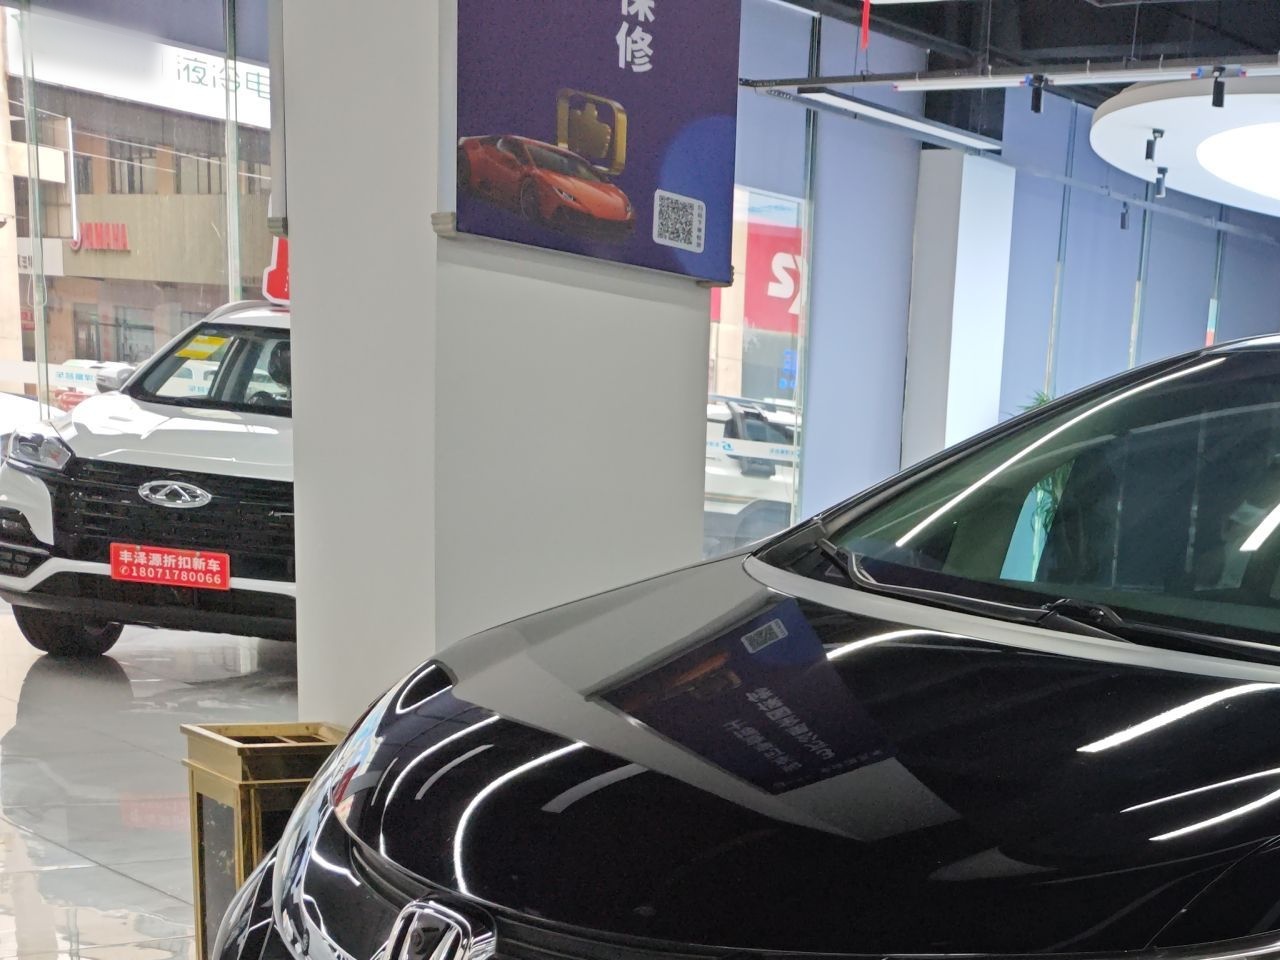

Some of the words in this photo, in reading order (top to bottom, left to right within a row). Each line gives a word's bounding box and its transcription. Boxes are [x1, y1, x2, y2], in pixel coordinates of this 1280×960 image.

[119, 550, 221, 572] 丰泽源折扣新车
[131, 566, 221, 584] 18071780066
